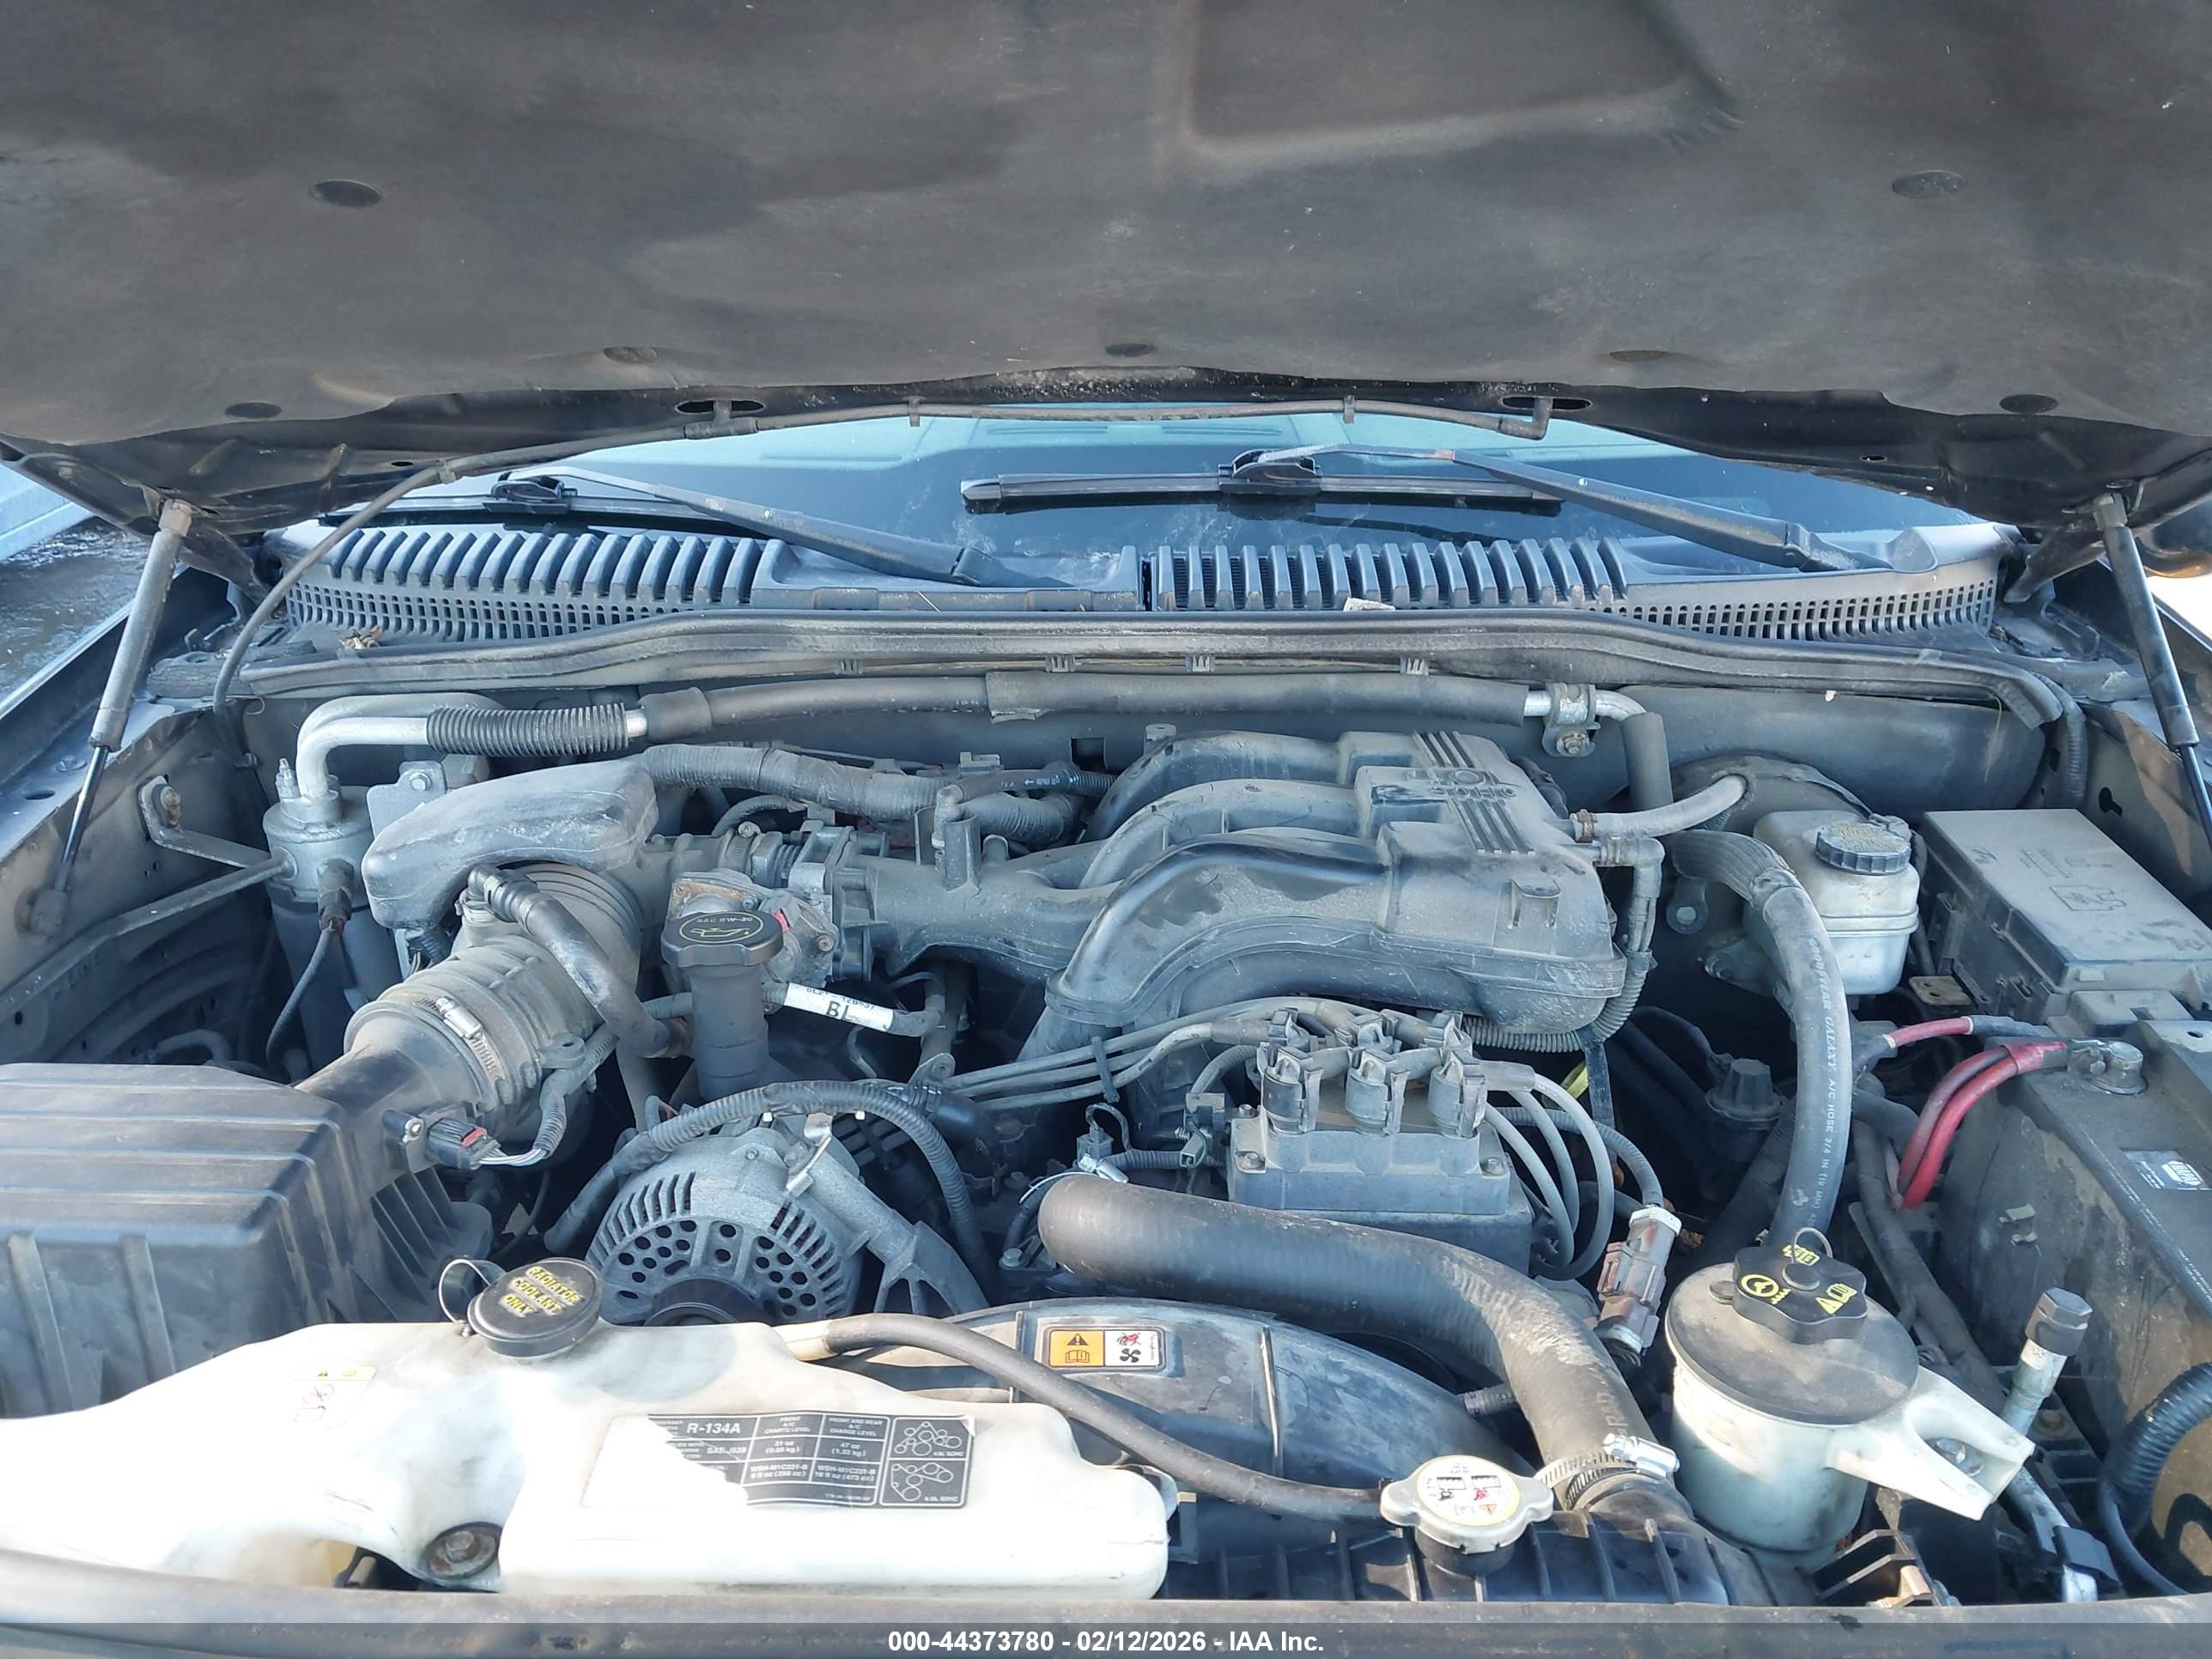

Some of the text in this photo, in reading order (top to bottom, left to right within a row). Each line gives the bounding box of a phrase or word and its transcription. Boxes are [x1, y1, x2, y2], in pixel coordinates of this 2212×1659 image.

[1808, 937, 1832, 1011] GOODYEAR
[1825, 1016, 1837, 1071] GALAXY
[1827, 1078, 1837, 1099] A/C
[1826, 1103, 1836, 1133] HOSE
[1823, 1136, 1833, 1154] 3/4
[1820, 1158, 1831, 1169] IN
[511, 1277, 562, 1314] COOLANT
[525, 1267, 581, 1304] RADIATOR
[501, 1294, 535, 1316] ONLY
[686, 1422, 741, 1434] R-134A
